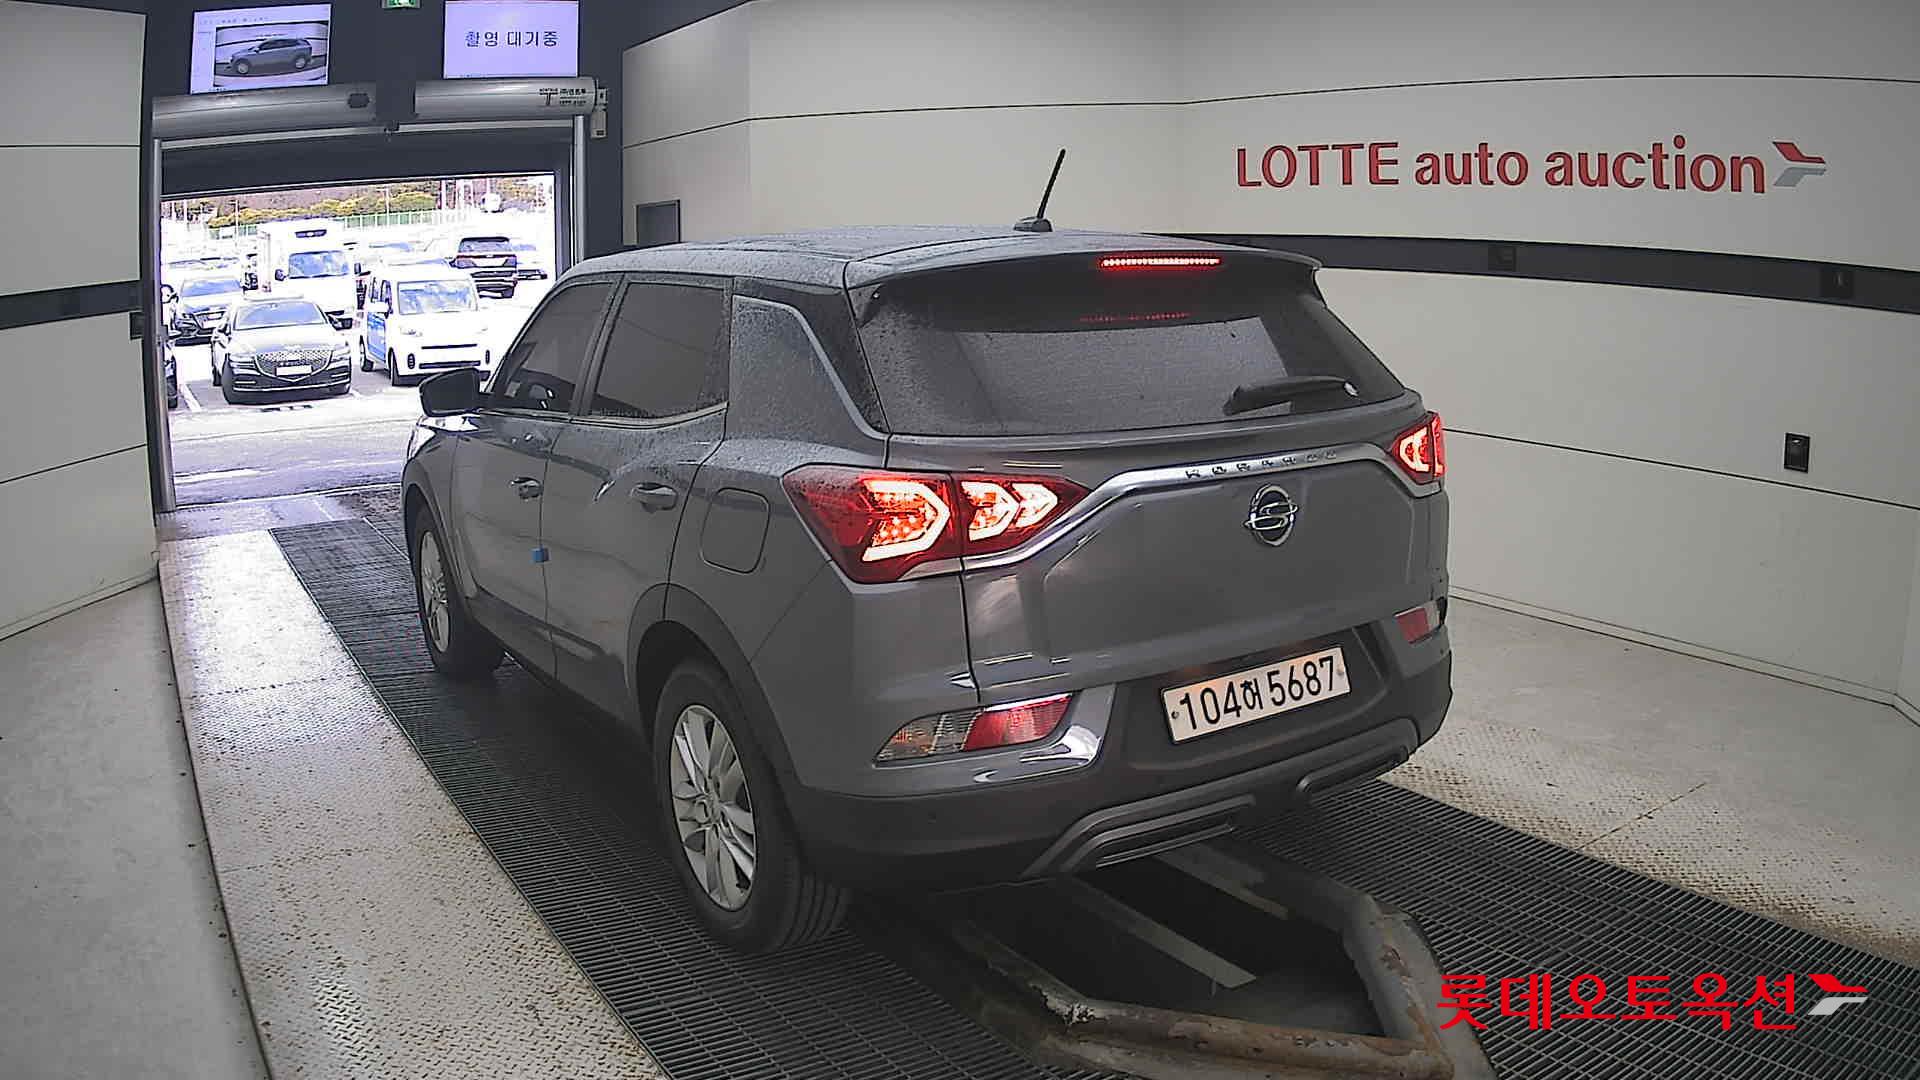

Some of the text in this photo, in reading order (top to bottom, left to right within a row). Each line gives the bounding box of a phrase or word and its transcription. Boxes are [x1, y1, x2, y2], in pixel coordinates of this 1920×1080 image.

[465, 31, 559, 47] 촬영 대기중
[1236, 135, 1765, 194] LOTTE auto auction
[1179, 655, 1335, 730] 104허5687
